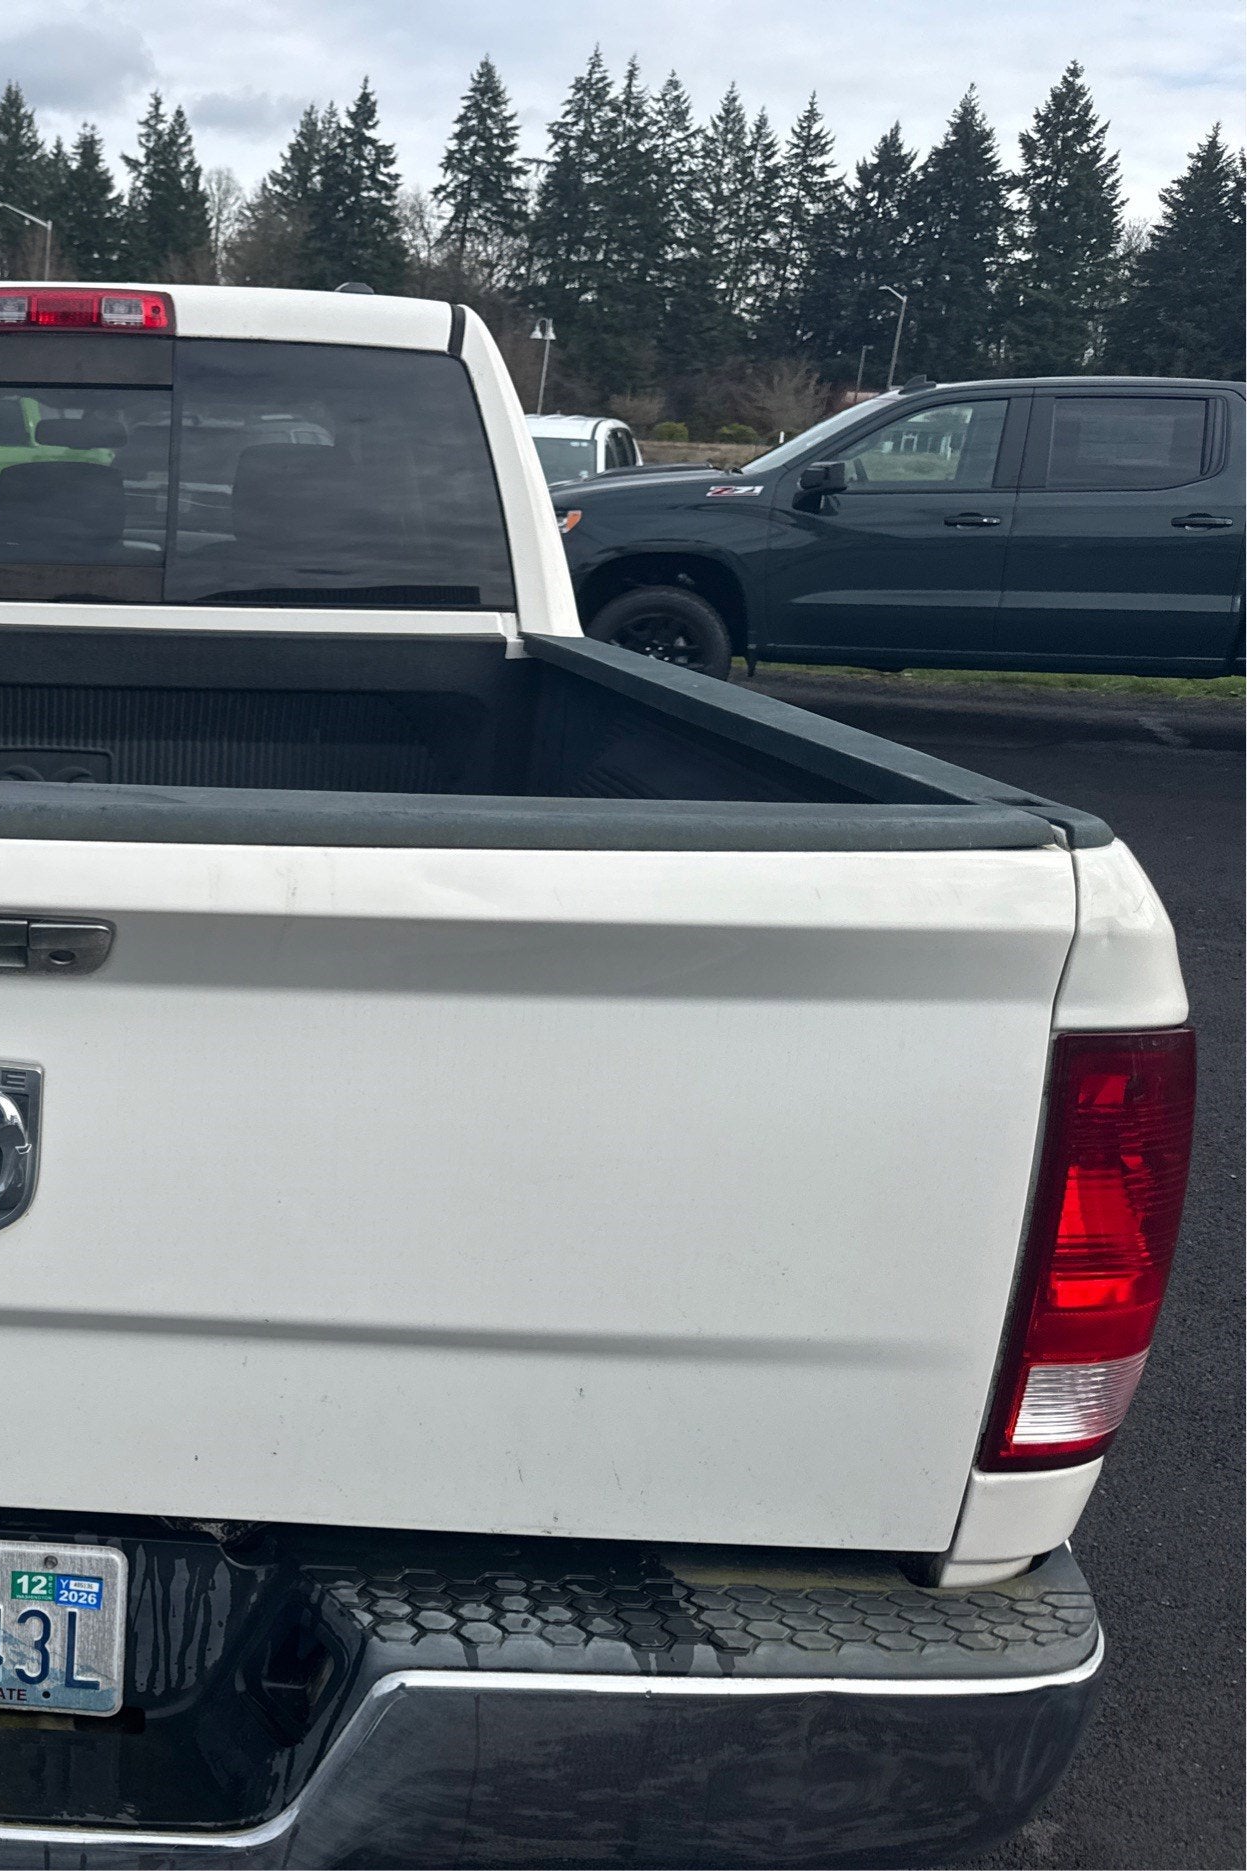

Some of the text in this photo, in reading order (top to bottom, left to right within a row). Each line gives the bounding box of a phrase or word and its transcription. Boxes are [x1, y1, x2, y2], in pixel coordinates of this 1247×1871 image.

[706, 485, 764, 497] Z71
[16, 1574, 48, 1595] 12
[59, 1578, 69, 1589] Y
[58, 1589, 98, 1605] 2026
